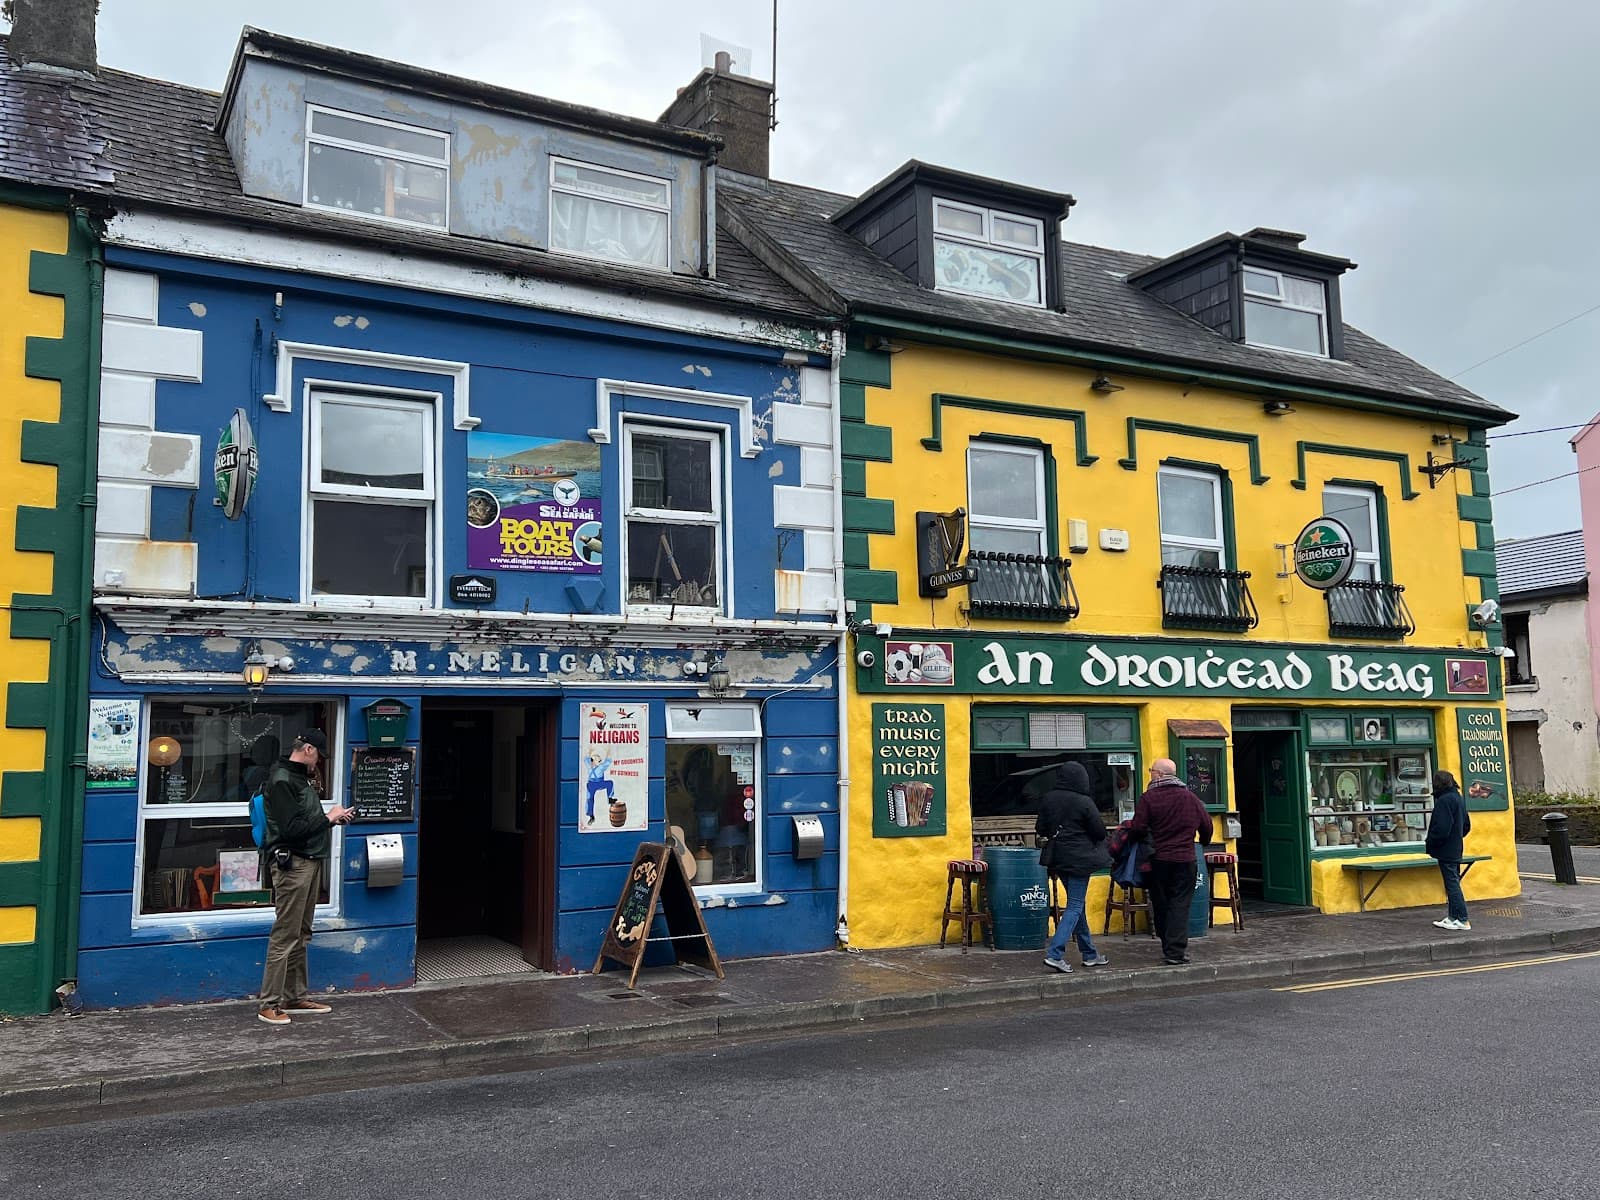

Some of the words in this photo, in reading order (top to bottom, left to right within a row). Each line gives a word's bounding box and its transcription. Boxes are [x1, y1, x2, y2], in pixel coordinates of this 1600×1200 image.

[500, 518, 574, 541] BOAT
[500, 538, 574, 557] TOURS
[1297, 546, 1347, 562] Heineken
[929, 570, 963, 587] GUINNESS
[448, 651, 636, 675] NELIGAN
[589, 730, 640, 744] NELIGANS
